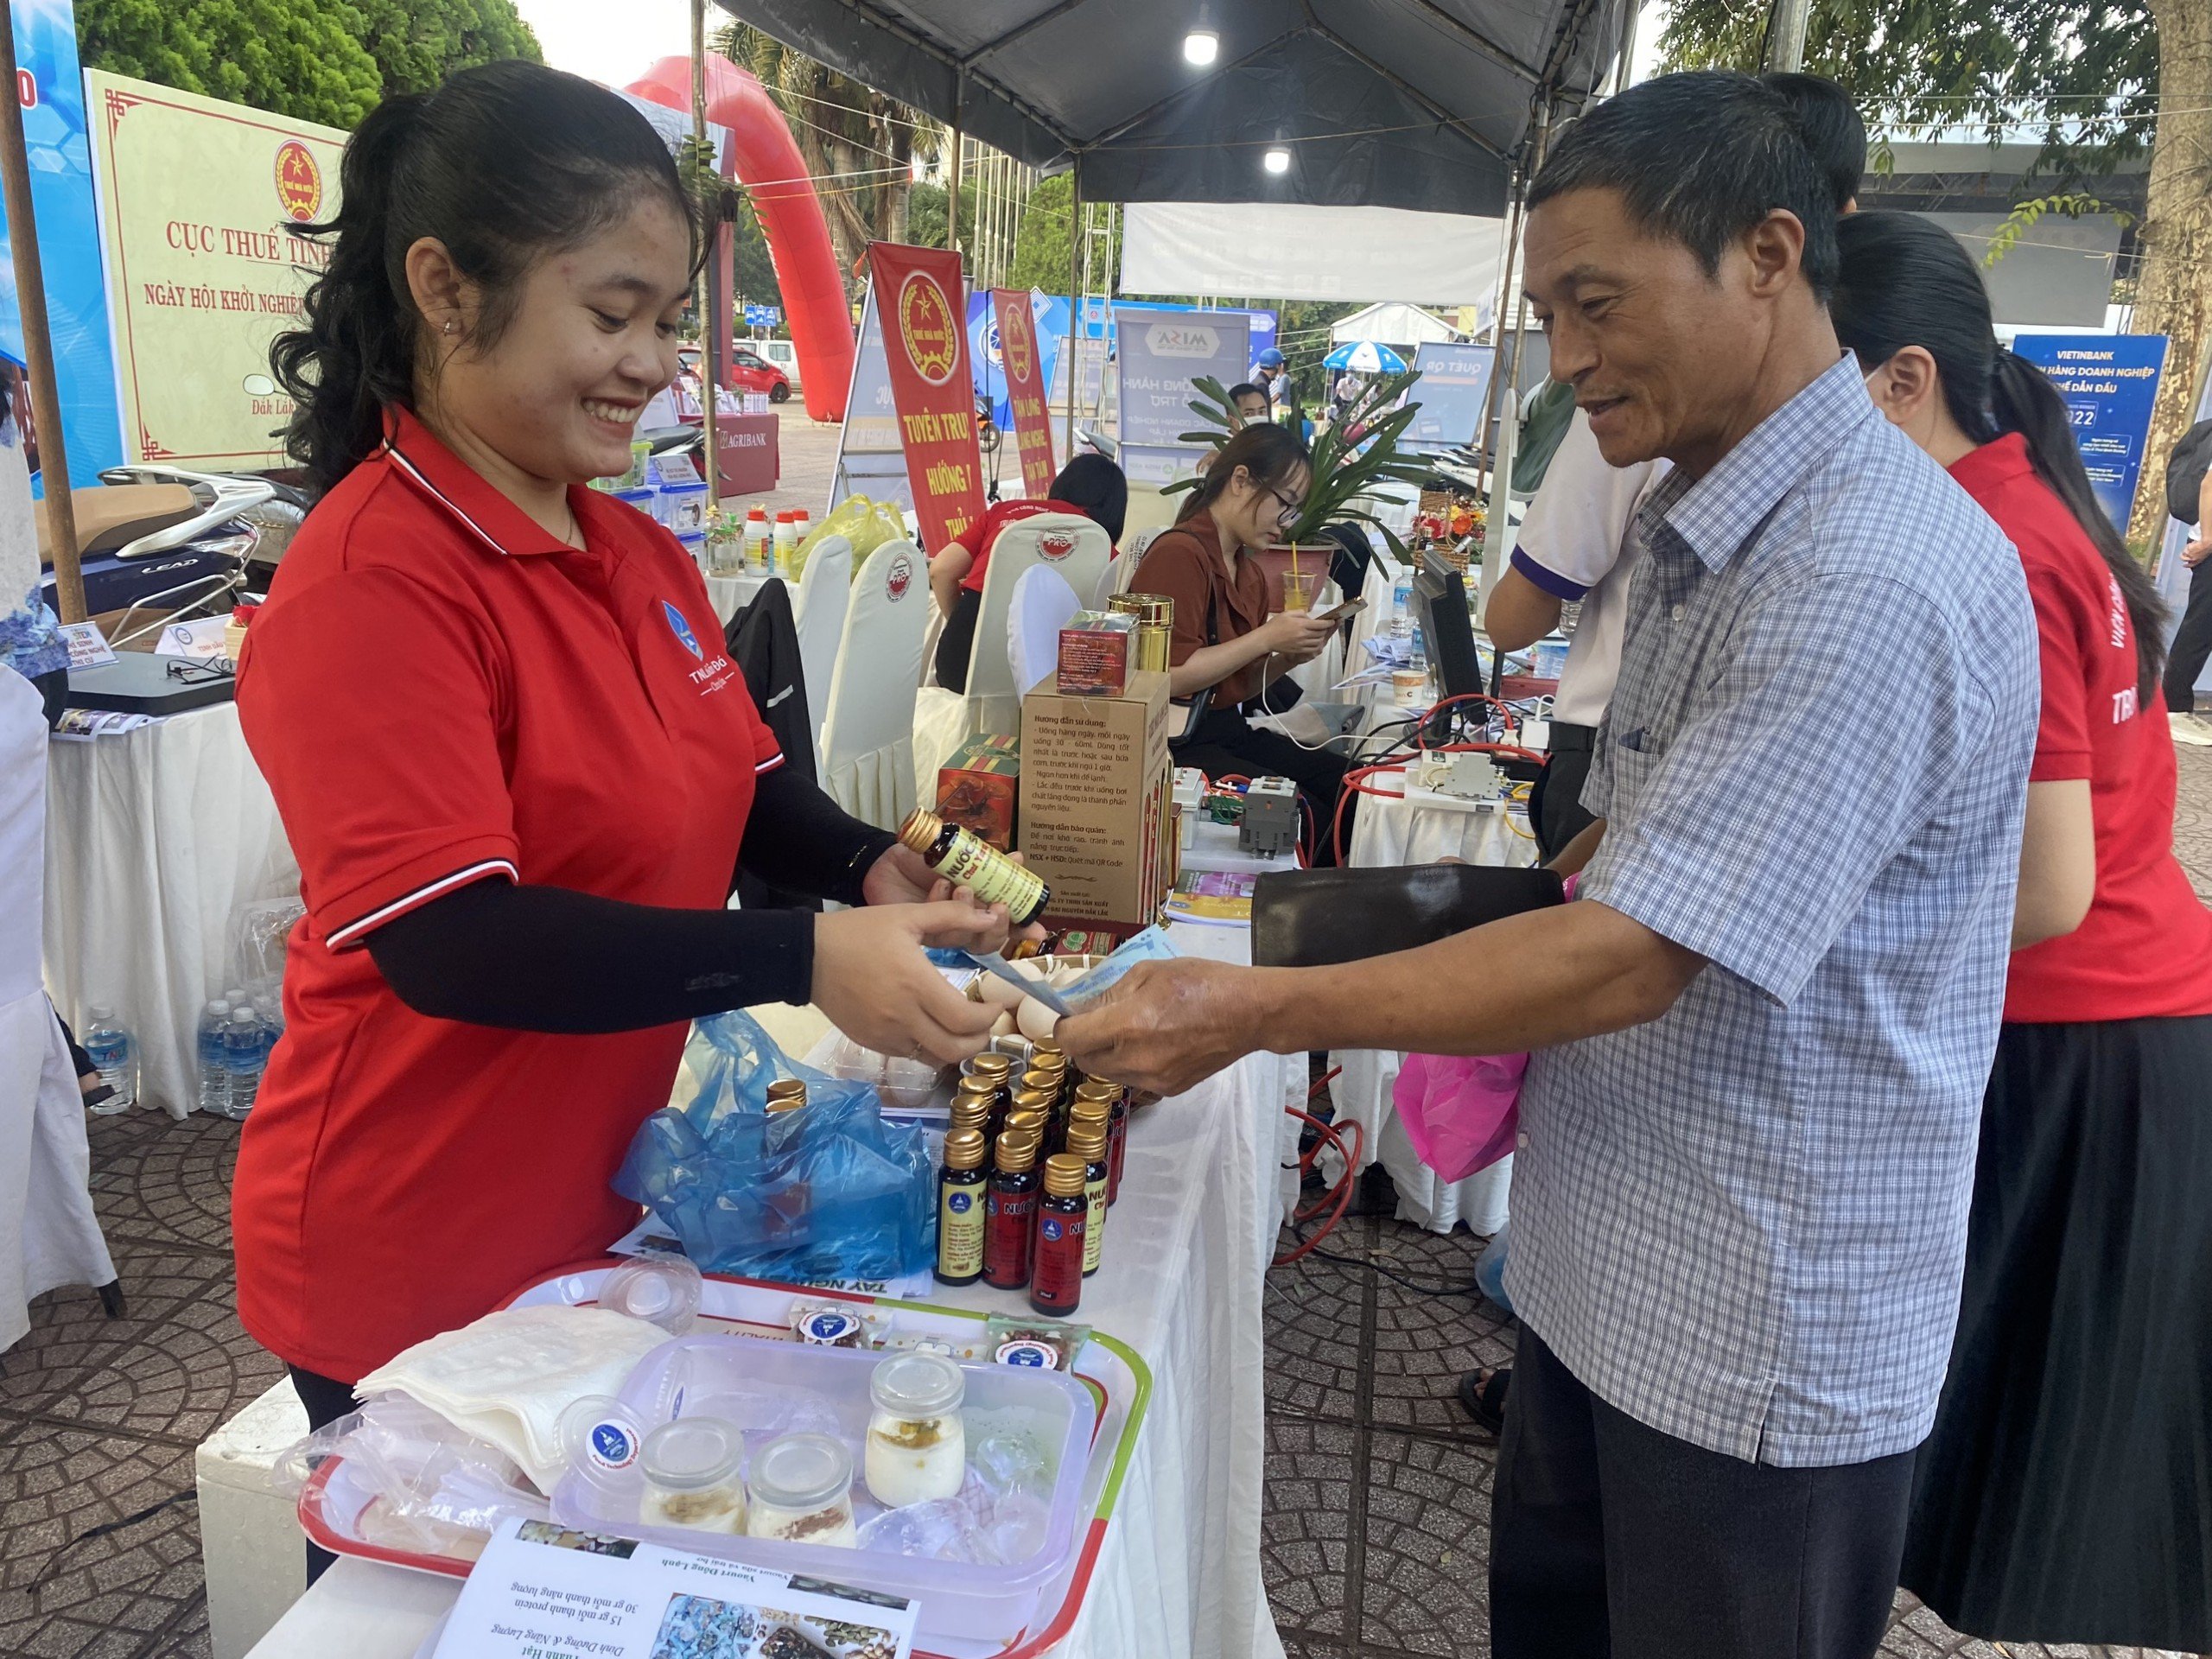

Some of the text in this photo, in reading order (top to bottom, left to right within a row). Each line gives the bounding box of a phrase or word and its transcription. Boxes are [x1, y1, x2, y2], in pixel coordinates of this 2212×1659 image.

[167, 221, 215, 257] CỤC
[221, 223, 281, 261] THUẾ
[143, 280, 186, 308] NGÀY
[190, 283, 217, 313] HỘI
[220, 284, 256, 313] KHỞI
[2056, 350, 2115, 361] VIETINBANK
[2047, 365, 2077, 377] HÀNG
[2077, 366, 2115, 378] DOANH
[2116, 366, 2156, 380] NGHIỆP
[2072, 379, 2118, 394] DẪN ĐẦU
[251, 397, 295, 415] Đắk Lắk
[903, 406, 943, 444] TUYÊN
[728, 433, 766, 448] AGRIBANK
[926, 459, 968, 497] HƯỚNG
[1048, 537, 1068, 548] PRO
[142, 558, 199, 575] LEAD
[1039, 727, 1057, 735] Uống
[1058, 728, 1076, 737] hàng
[946, 842, 976, 878] NƯỚC
[1096, 858, 1107, 867] QR
[1106, 859, 1123, 868] Code
[662, 1559, 689, 1571] Lạnh
[721, 1571, 755, 1583] Yaourt
[758, 1569, 788, 1581] Yaourt
[510, 1581, 639, 1615] 30 gr mỗi thanh năng lượng
[515, 1599, 622, 1627] 15 gr mỗi thanh protein
[491, 1624, 625, 1657] Dinh Dưỡng & Năng Lượng
